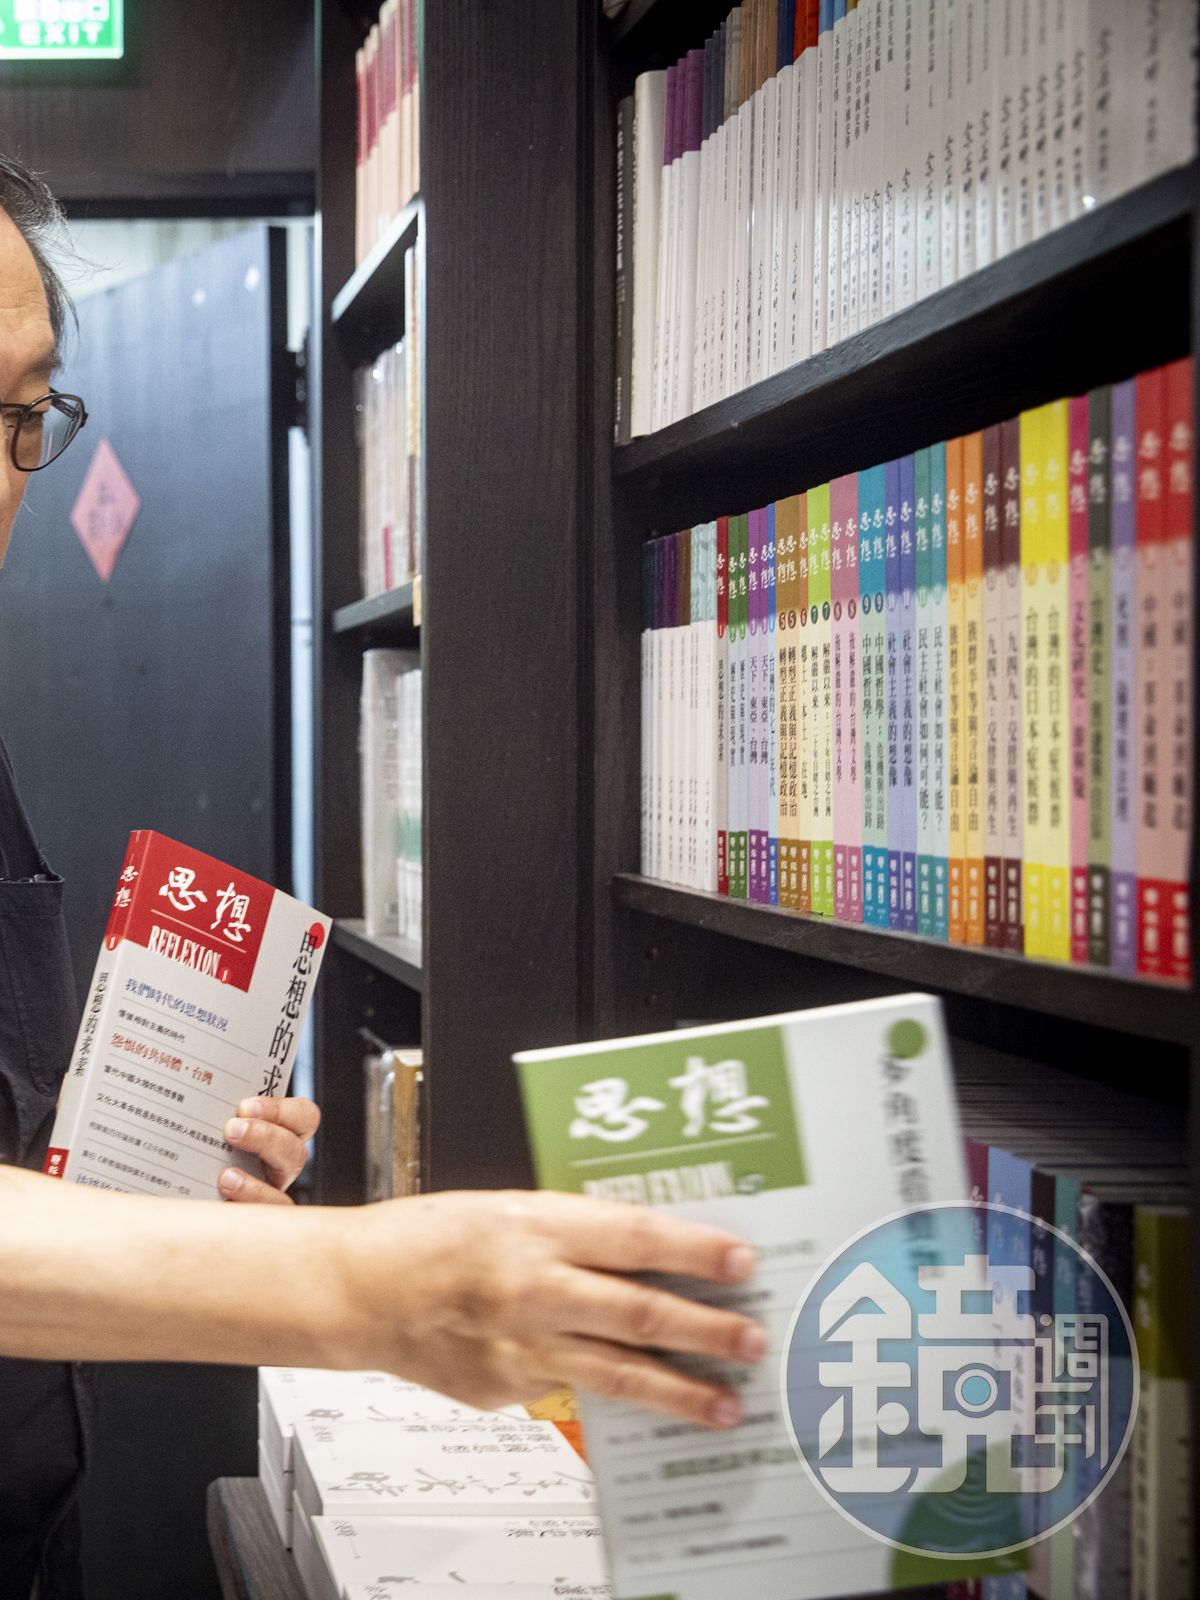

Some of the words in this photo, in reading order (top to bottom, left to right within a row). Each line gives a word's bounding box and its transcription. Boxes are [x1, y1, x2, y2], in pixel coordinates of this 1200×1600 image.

[19, 20, 104, 46] EXIT
[965, 482, 978, 540] 思想
[984, 473, 998, 532] 思想
[1004, 466, 1019, 527] 思想
[1024, 463, 1039, 524] 思想
[1045, 457, 1060, 519] 思想
[860, 511, 872, 562] 思想
[872, 508, 884, 560] 思想
[885, 505, 897, 558] 思想
[900, 501, 912, 555] 思想
[915, 497, 928, 551] 思想
[931, 493, 943, 548] 思想
[947, 488, 959, 544] 思想
[760, 544, 769, 589] 思想
[768, 541, 777, 586] 思想
[777, 538, 787, 583] 思想
[786, 535, 797, 581] 思想
[799, 531, 809, 578] 思想
[809, 528, 819, 576] 思想
[820, 523, 830, 571] 思想
[831, 521, 842, 570] 思想
[845, 518, 857, 568] 思想
[717, 553, 726, 595] 思想
[728, 556, 738, 599] 思想
[738, 552, 747, 595] 思想
[748, 547, 758, 591] 思想
[115, 866, 139, 907] 思想
[158, 866, 252, 942] 思想
[147, 925, 222, 977] REFLEXION
[257, 930, 320, 1097] 思想的求
[568, 1055, 770, 1142] 思想
